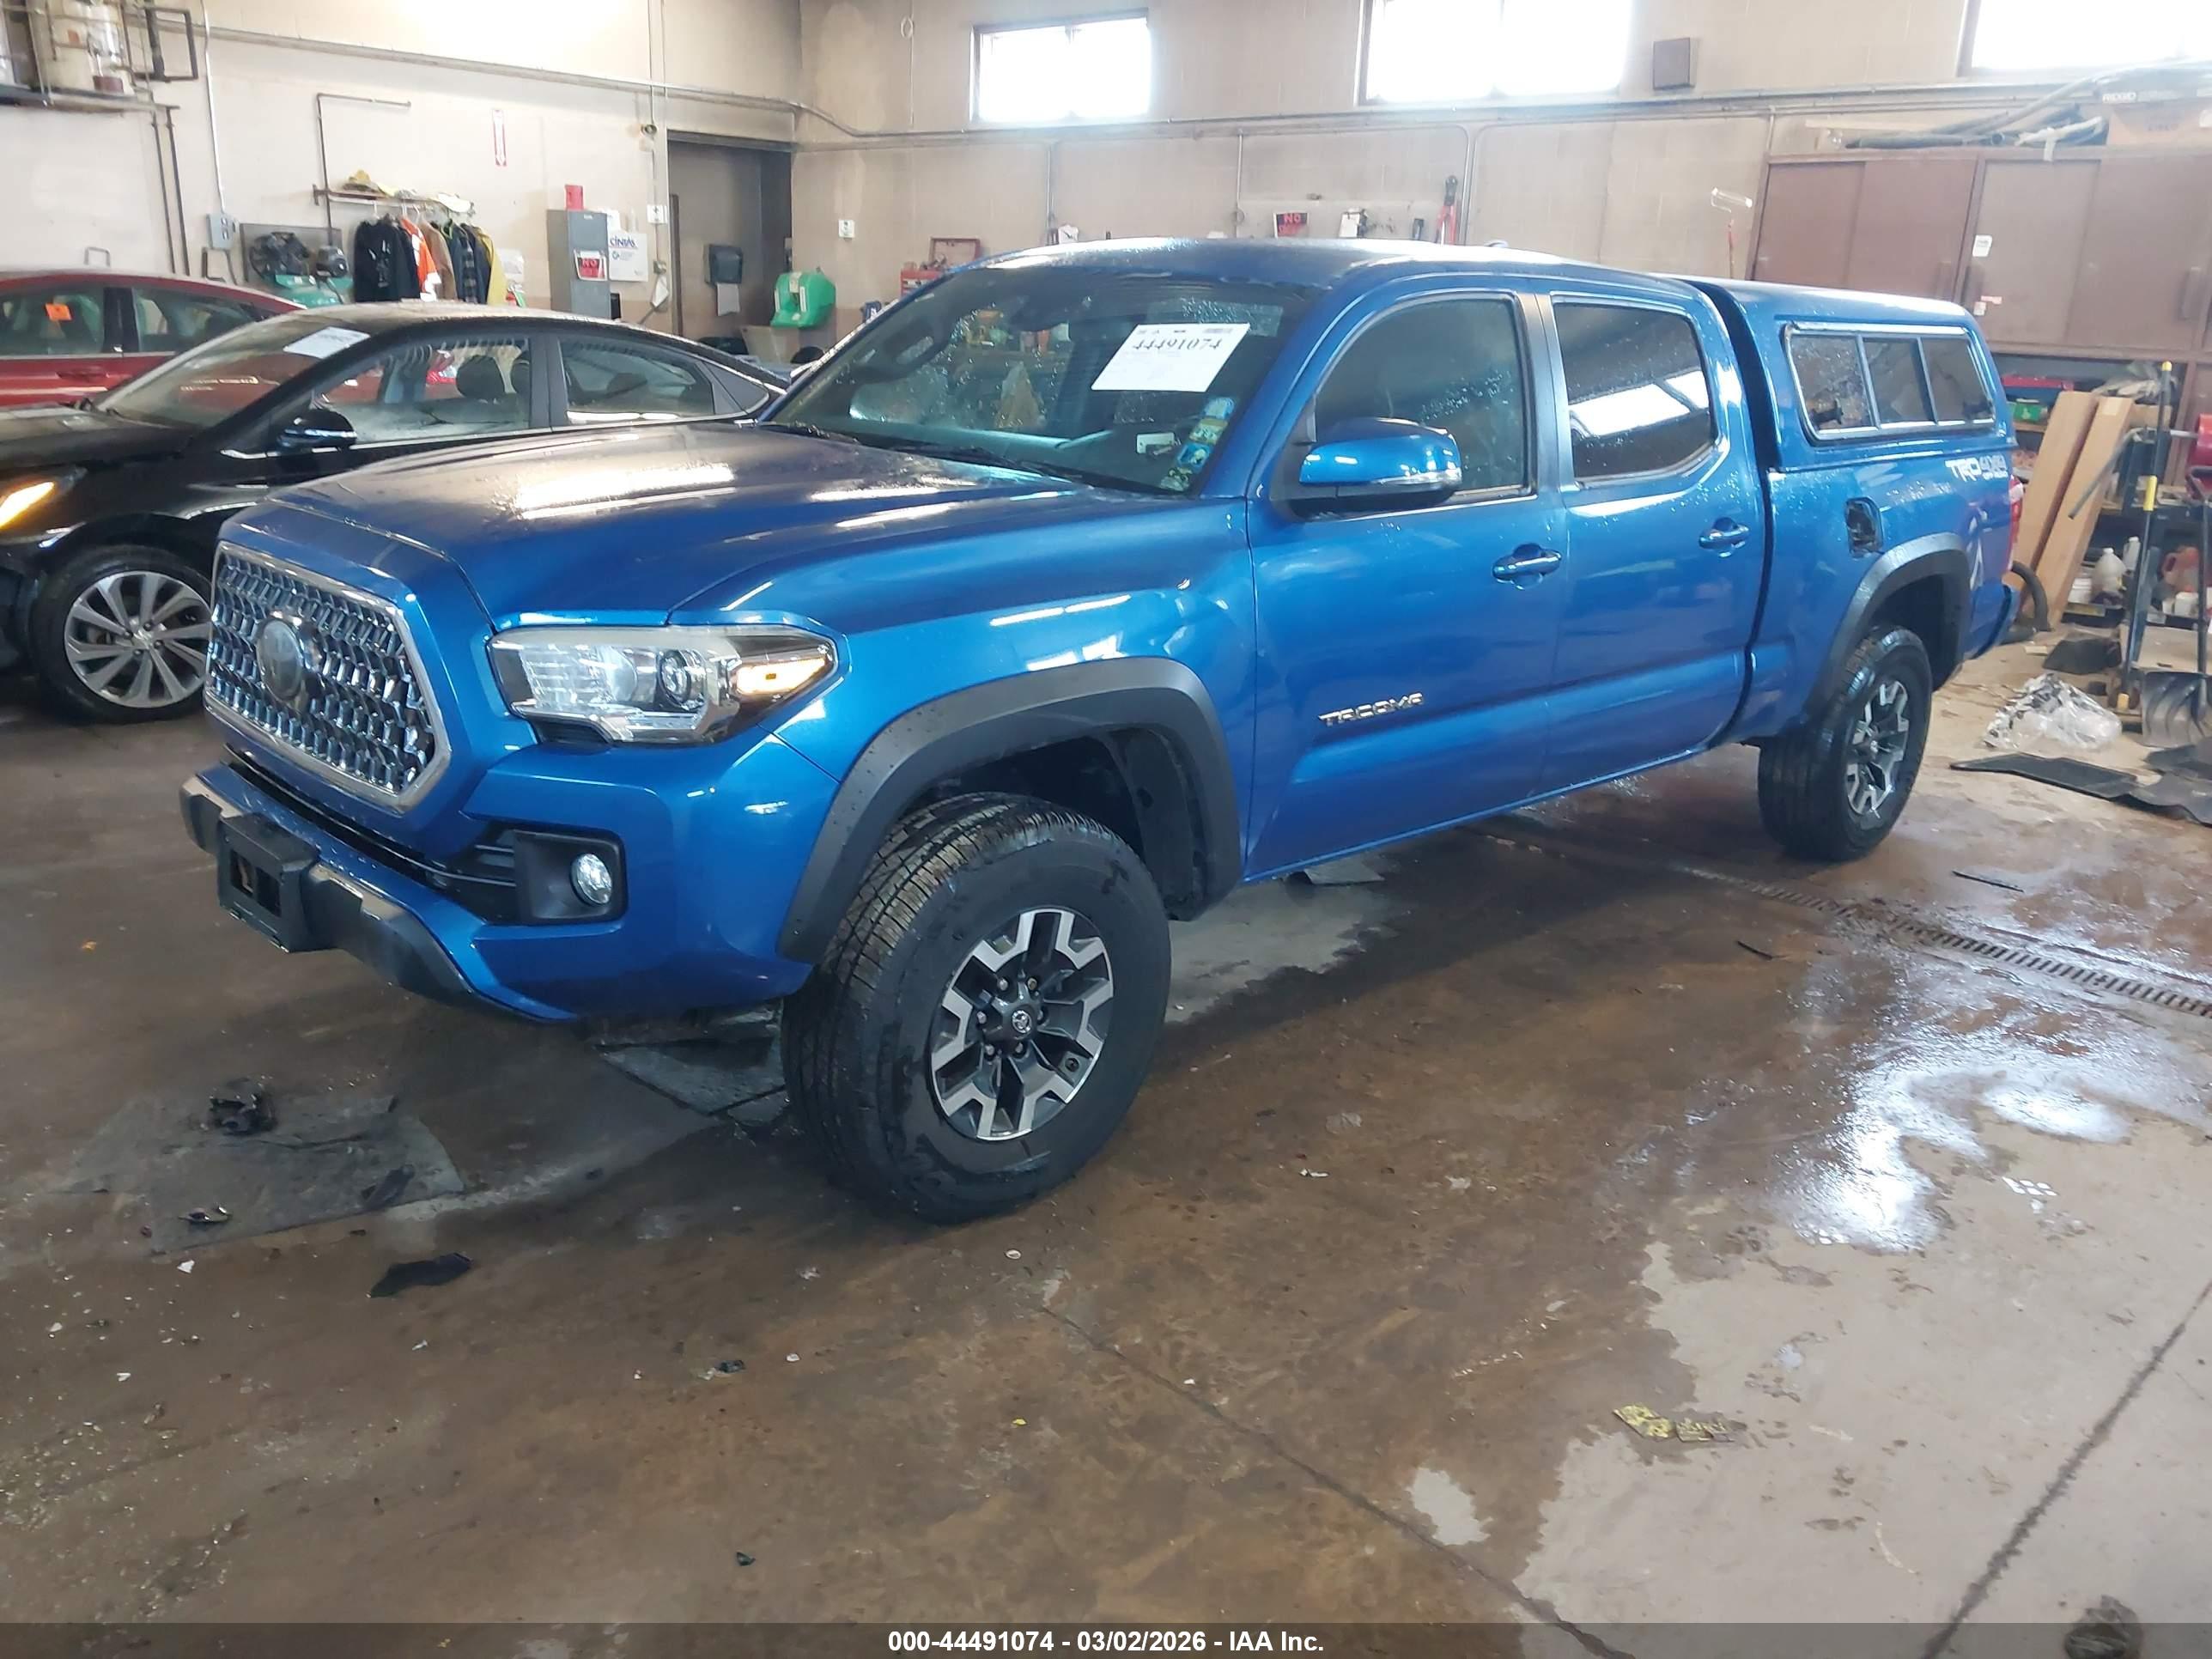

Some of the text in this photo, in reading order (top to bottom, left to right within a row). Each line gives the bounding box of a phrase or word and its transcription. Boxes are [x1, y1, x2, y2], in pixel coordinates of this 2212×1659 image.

[1284, 213, 1302, 223] NO
[1133, 338, 1223, 350] 44491074
[1944, 457, 1982, 482] TRD
[1318, 692, 1423, 726] TACOMA
